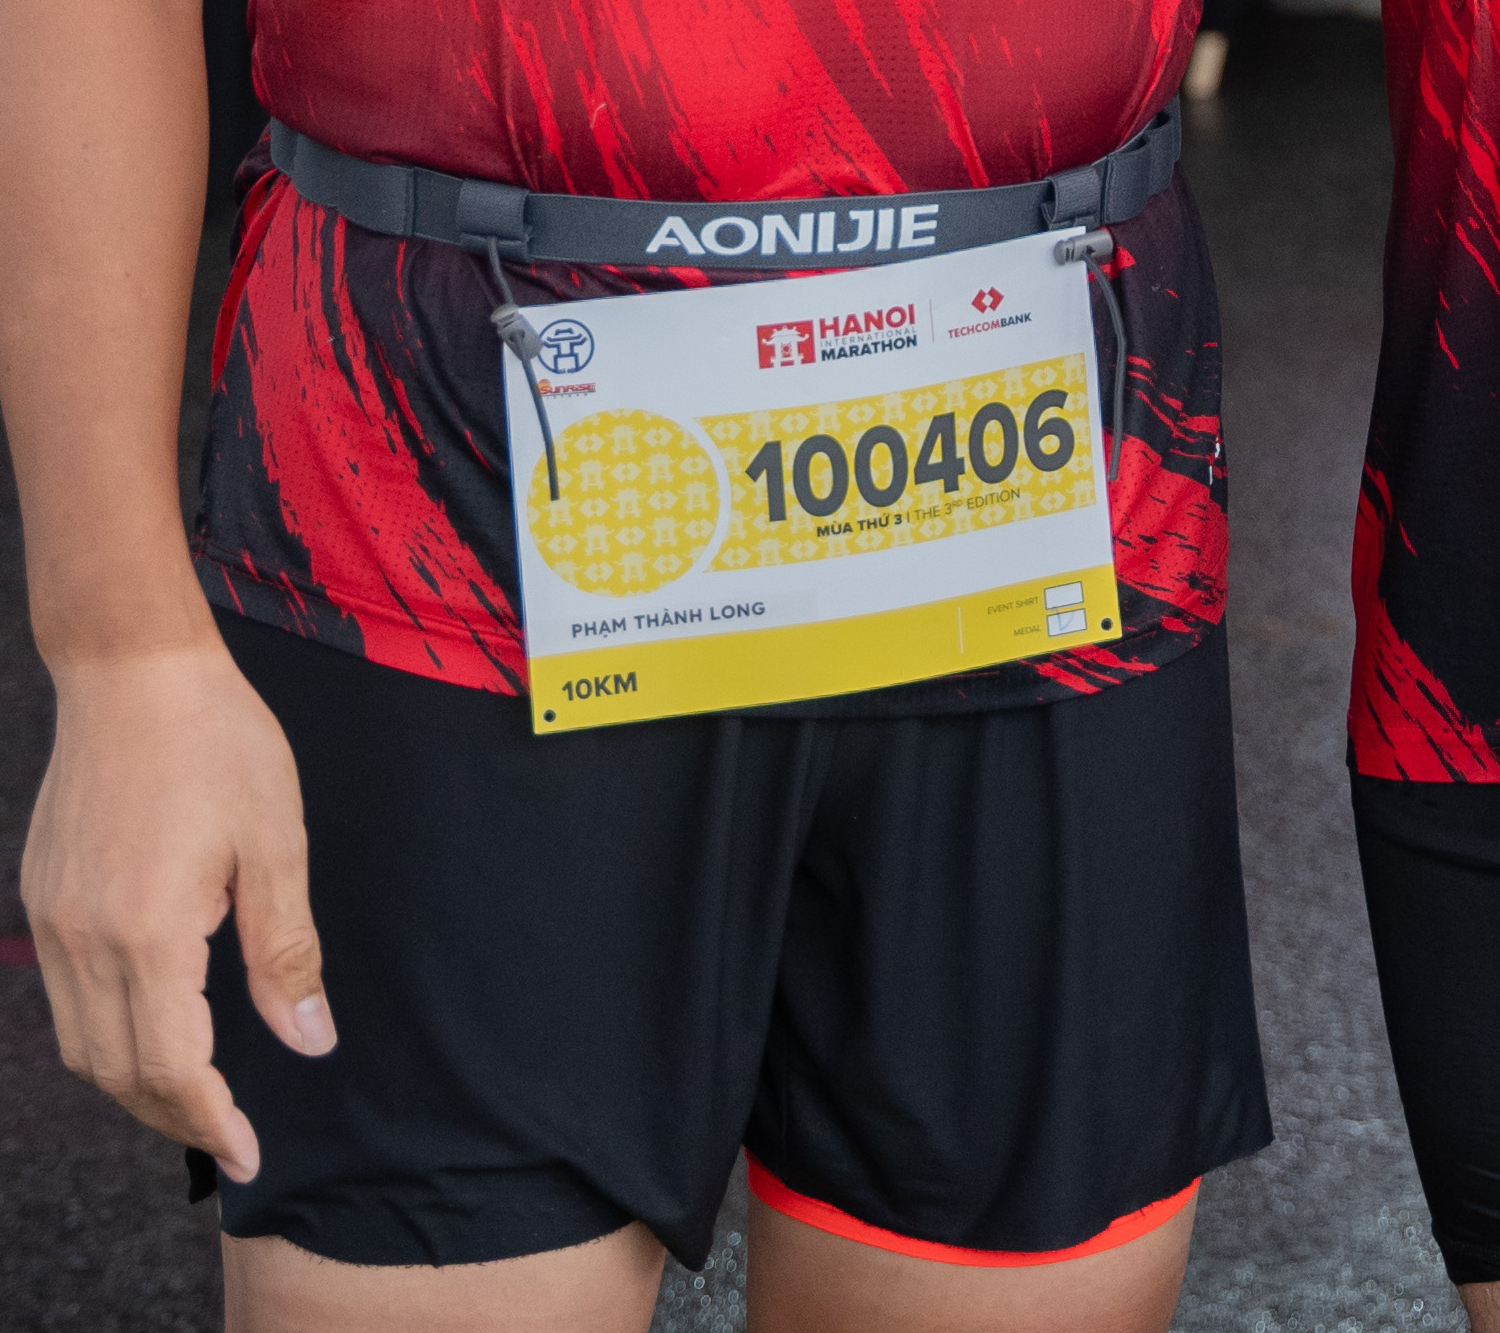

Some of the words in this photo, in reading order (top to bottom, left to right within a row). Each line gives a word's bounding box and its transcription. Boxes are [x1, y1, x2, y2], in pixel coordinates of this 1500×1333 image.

[645, 203, 940, 257] AONIJIE
[818, 303, 916, 339] HANOI
[948, 311, 1033, 340] TECHCOMBANK
[820, 326, 918, 348] INTERNATIONAL
[821, 334, 918, 362] MARATHON
[744, 388, 1076, 523] 100406
[816, 517, 855, 538] MÙA
[857, 511, 891, 532] THỨ
[893, 513, 904, 527] 3
[914, 507, 941, 521] THE
[967, 487, 1021, 511] EDITION
[571, 617, 628, 639] PHẠM
[633, 608, 703, 630] THÀNH
[710, 601, 766, 621] LONG
[987, 601, 1014, 615] EVENT
[1015, 596, 1039, 609] SHIRT
[1013, 624, 1042, 637] MEDAL
[561, 671, 639, 702] 10KM
